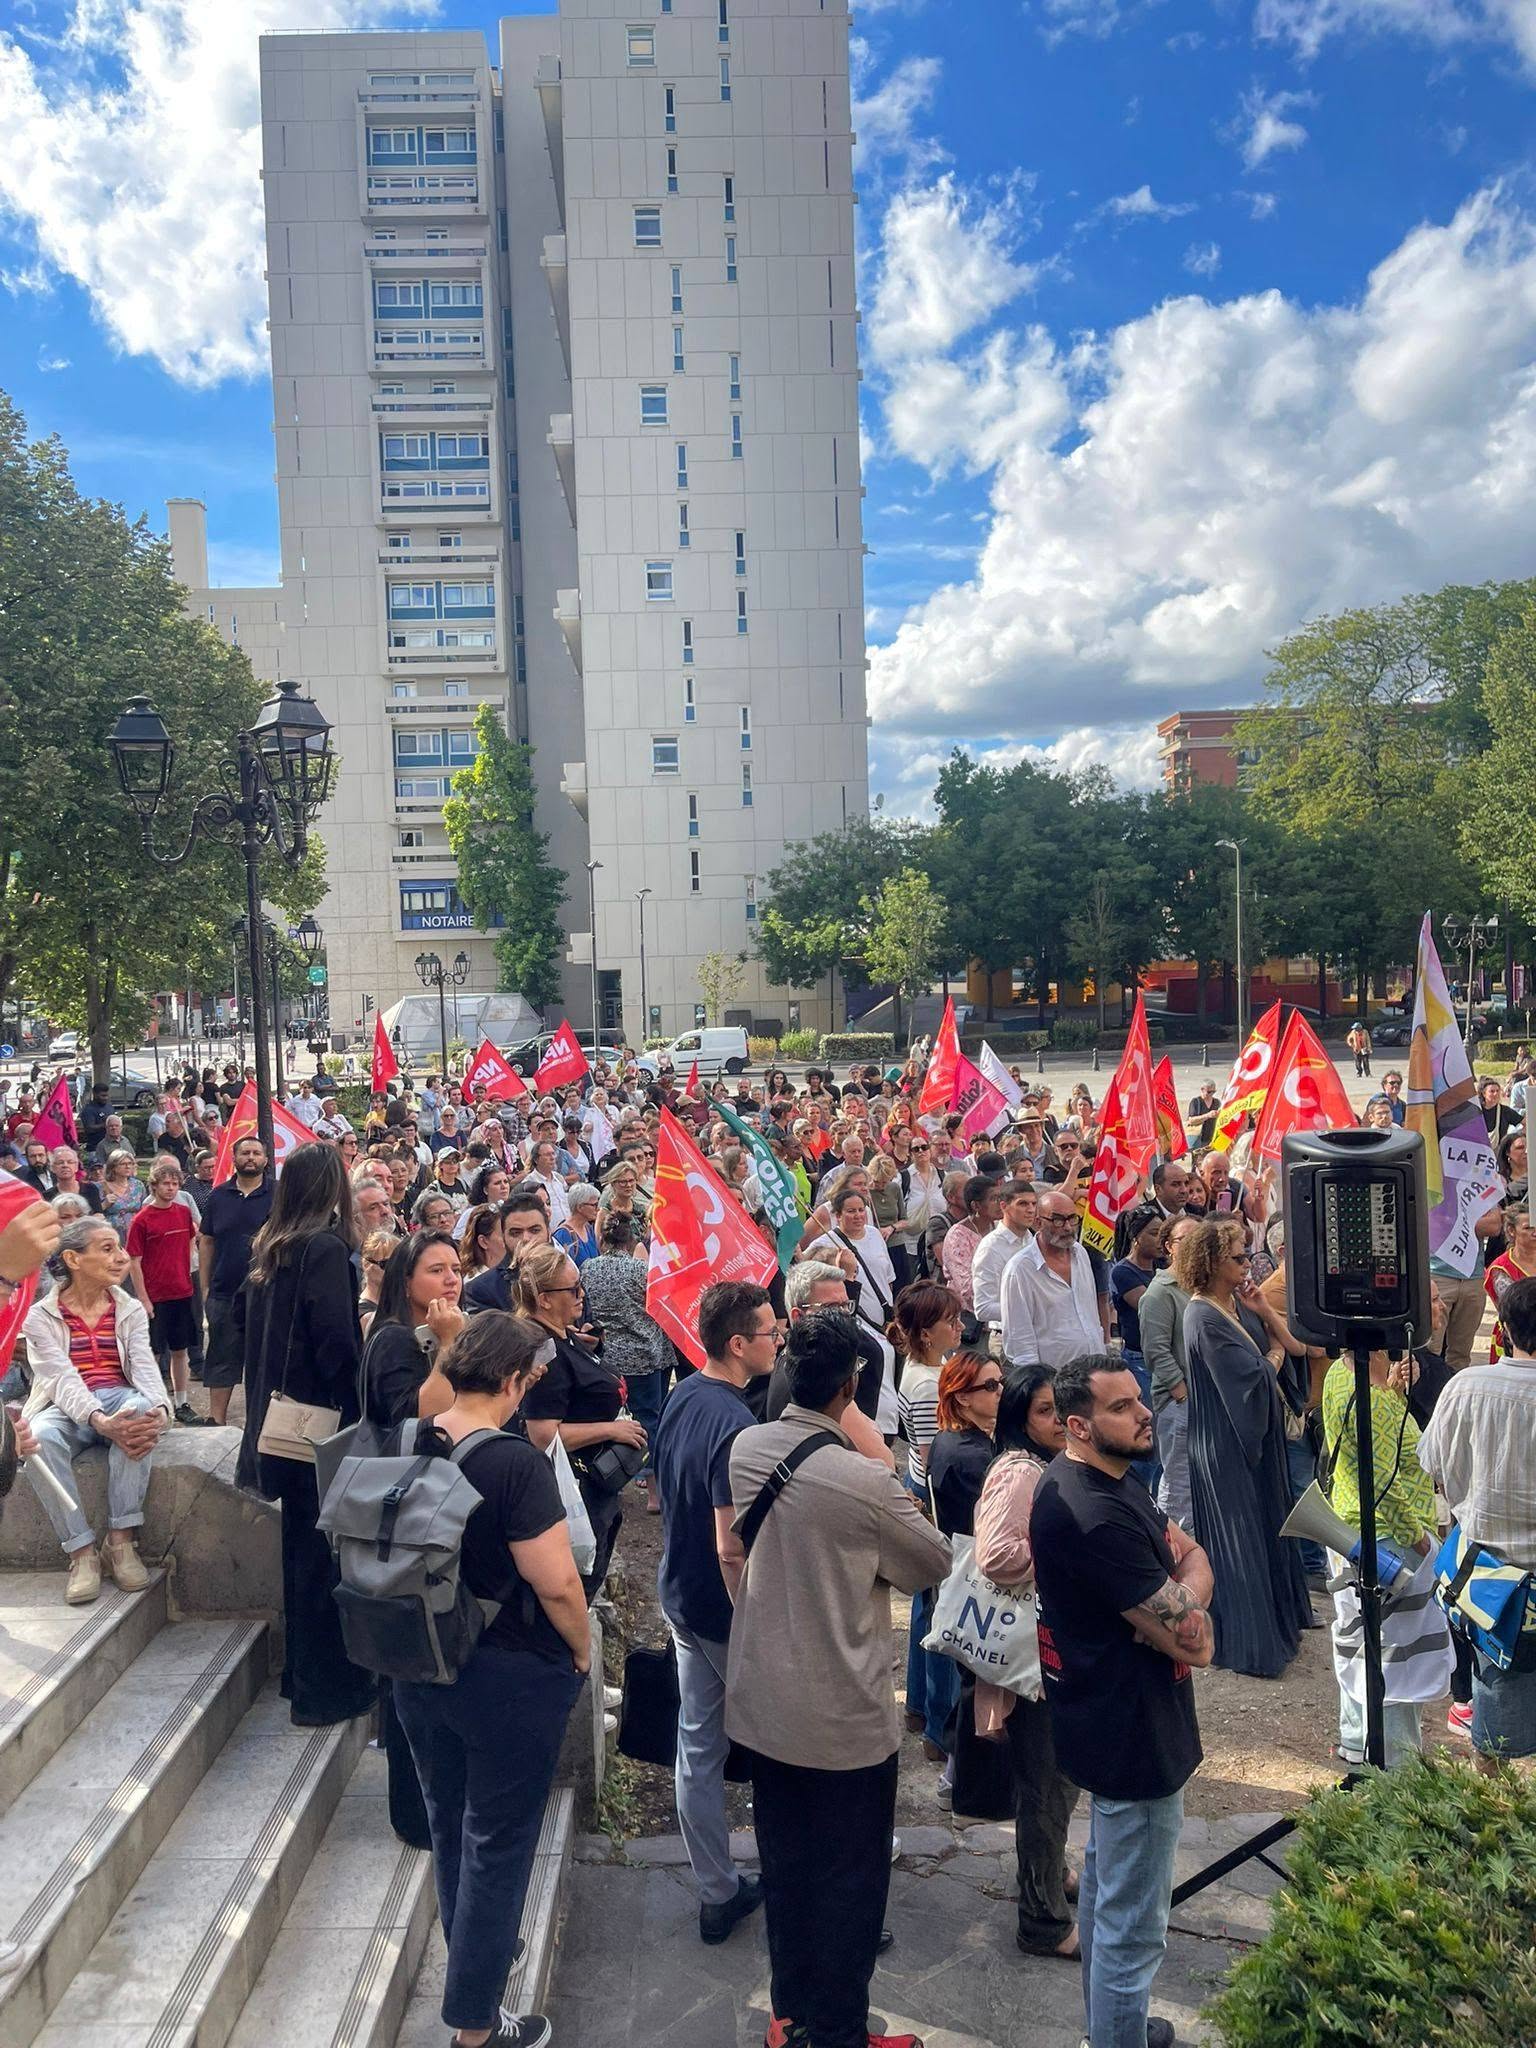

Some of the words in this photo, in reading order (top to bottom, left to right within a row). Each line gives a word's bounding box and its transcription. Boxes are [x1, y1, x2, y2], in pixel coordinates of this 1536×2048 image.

[1447, 1147, 1469, 1164] LA
[1475, 1153, 1500, 1173] FS
[965, 1574, 978, 1589] LE
[984, 1581, 1032, 1602] GRAND
[941, 1630, 1009, 1666] CHANEL
[993, 1630, 1006, 1641] DE
